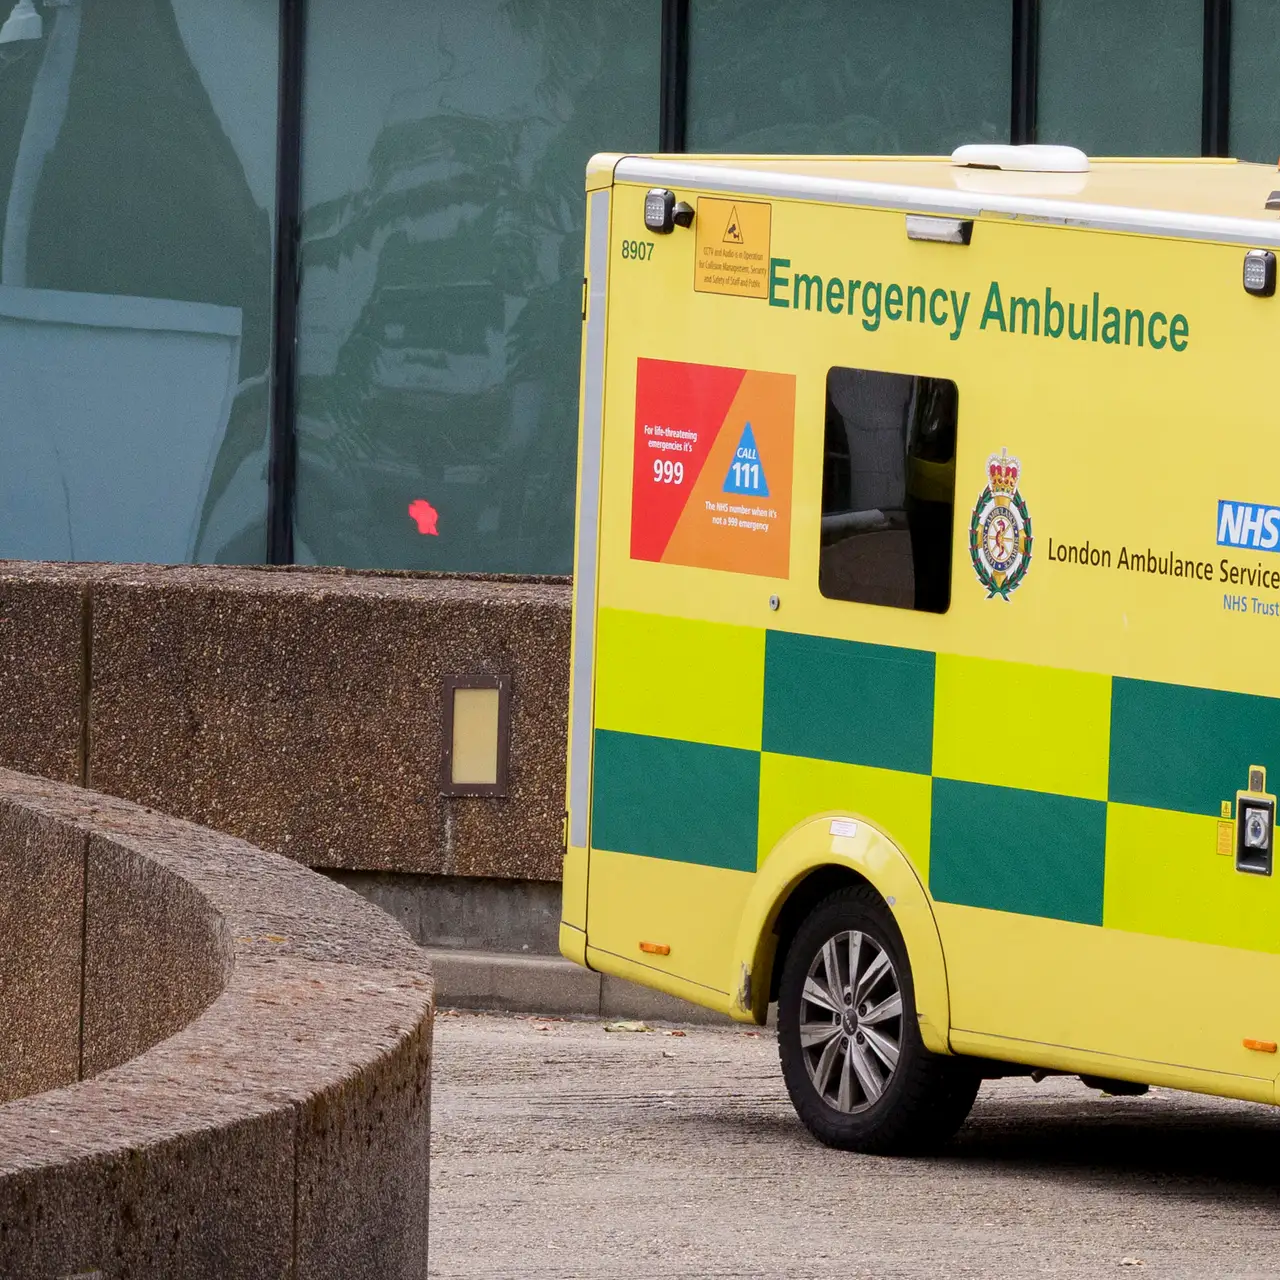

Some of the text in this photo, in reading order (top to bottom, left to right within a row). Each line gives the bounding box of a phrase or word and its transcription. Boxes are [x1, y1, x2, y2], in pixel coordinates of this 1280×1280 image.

[622, 240, 654, 261] 8907
[769, 257, 1189, 352] Emergency Ambulance
[644, 425, 697, 442] For life-threatening
[648, 439, 682, 452] emergencies
[736, 447, 757, 460] CALL
[653, 459, 684, 485] 999
[732, 462, 759, 489] 111
[705, 501, 715, 511] The
[716, 502, 728, 513] NHS
[729, 504, 751, 516] number
[752, 506, 767, 517] when
[712, 516, 722, 525] not
[728, 517, 738, 527] 999
[739, 520, 769, 533] emergency
[1218, 504, 1280, 549] NHS
[1048, 537, 1280, 589] London Ambulance Service
[1223, 594, 1280, 617] NHS Trust
